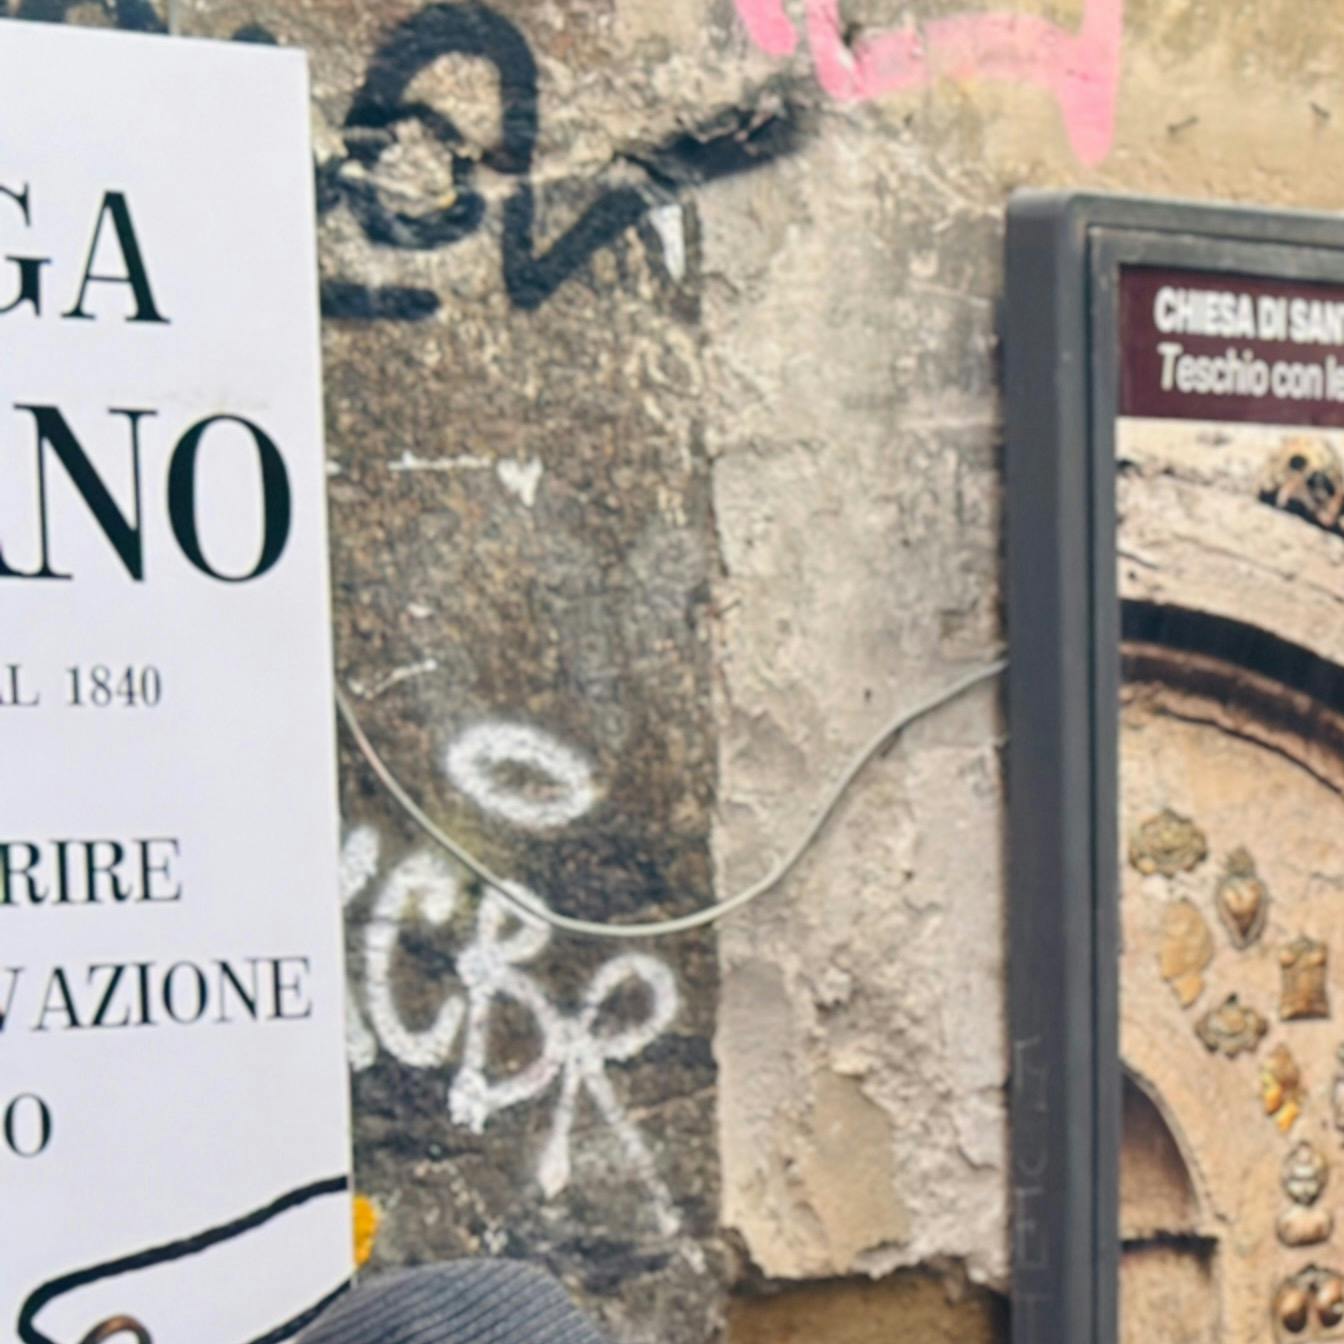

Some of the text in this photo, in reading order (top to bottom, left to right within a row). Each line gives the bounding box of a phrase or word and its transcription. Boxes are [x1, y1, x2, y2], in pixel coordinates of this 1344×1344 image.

[1153, 285, 1256, 339] CHIESA
[1257, 294, 1288, 342] DI
[1156, 341, 1270, 399] Teschio
[1271, 360, 1324, 400] con
[65, 664, 163, 708] 1840
[3, 1091, 54, 1159] O
